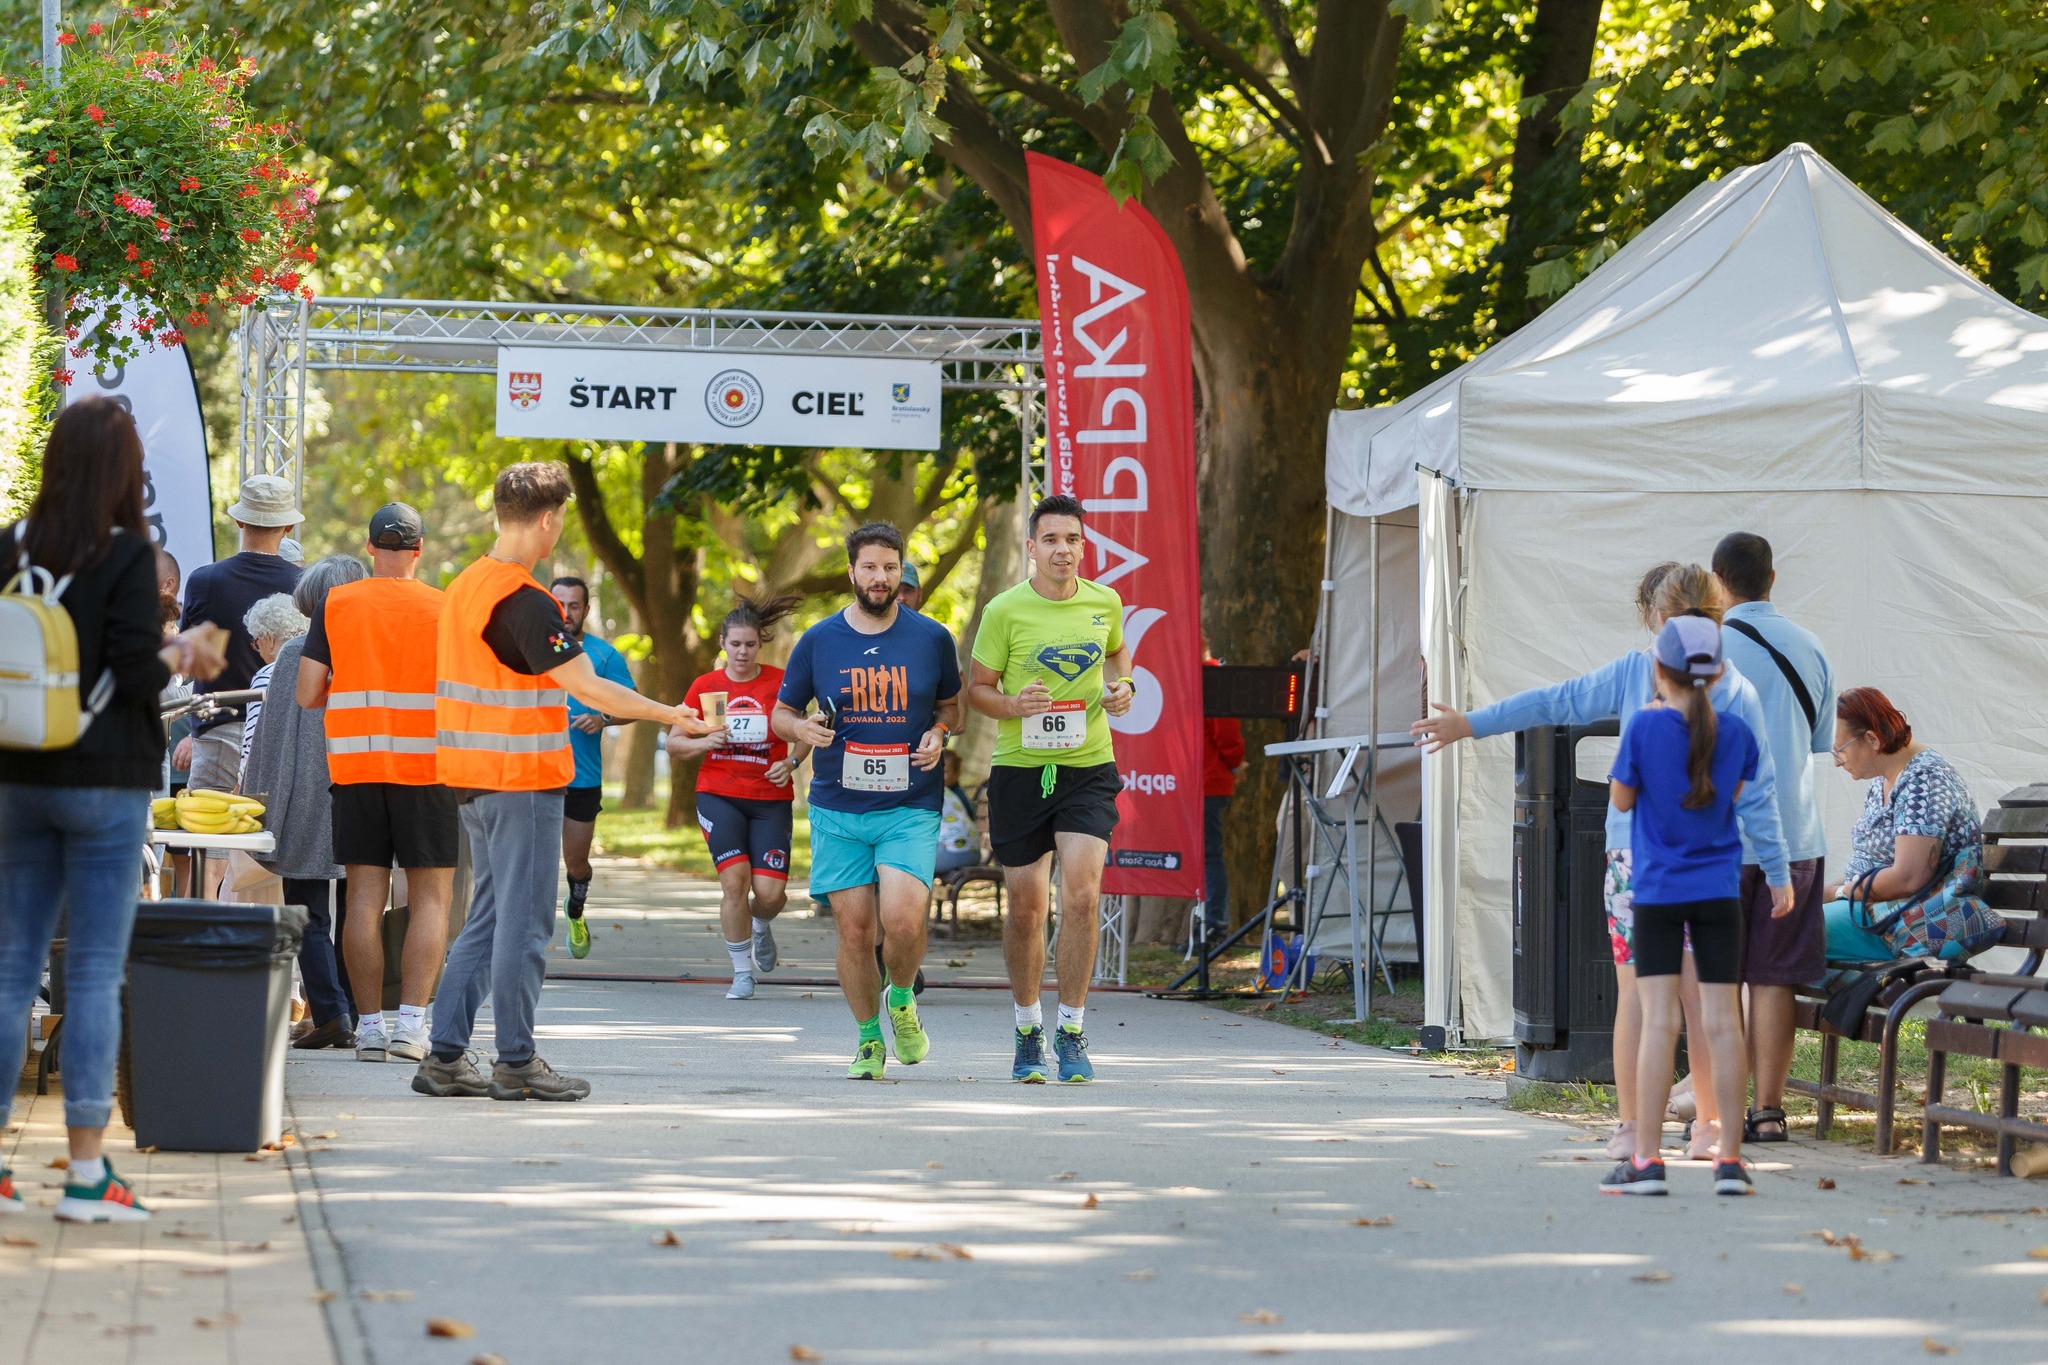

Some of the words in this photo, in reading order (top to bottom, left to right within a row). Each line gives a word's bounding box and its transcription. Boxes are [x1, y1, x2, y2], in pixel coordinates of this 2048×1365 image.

[569, 376, 677, 410] ŠTART
[792, 391, 864, 416] CIEĽ
[851, 665, 908, 713] RUN
[733, 718, 750, 730] 27
[1042, 715, 1066, 732] 66
[863, 758, 887, 775] 65
